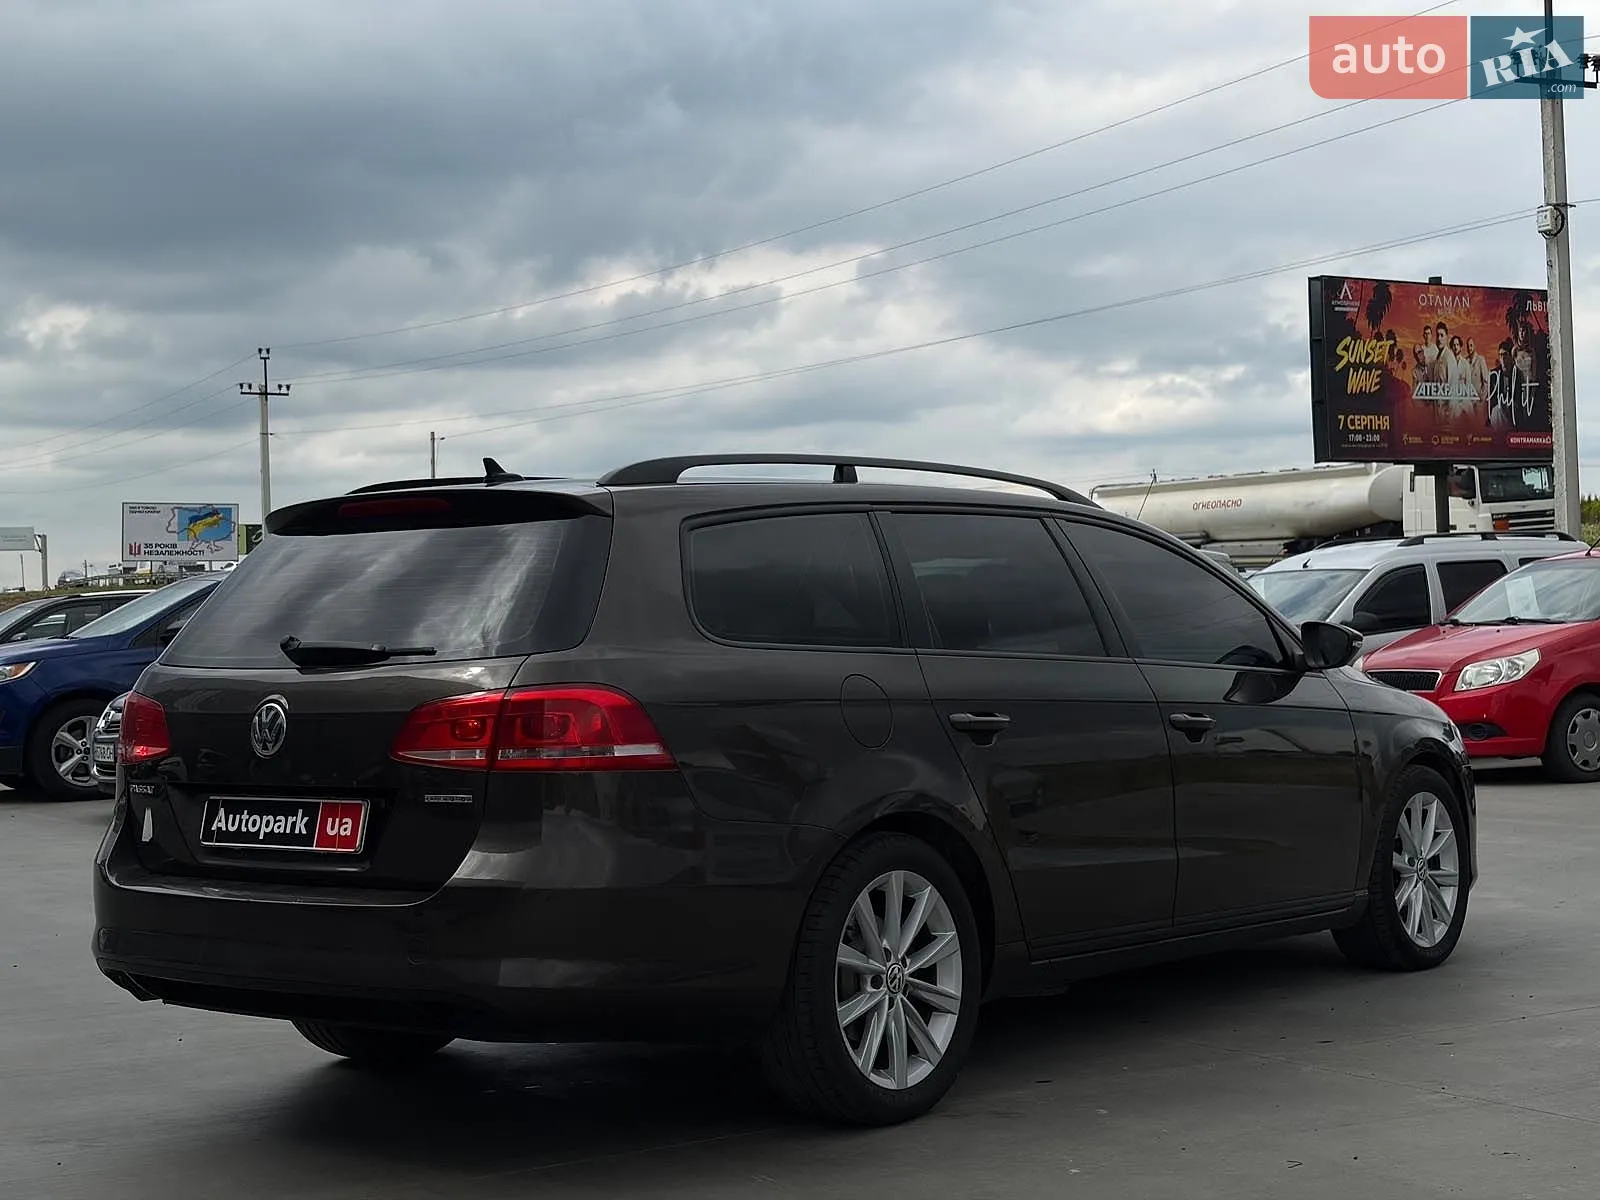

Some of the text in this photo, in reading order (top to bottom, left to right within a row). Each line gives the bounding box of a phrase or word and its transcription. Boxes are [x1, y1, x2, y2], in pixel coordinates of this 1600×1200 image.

[1418, 294, 1470, 308] OTAMAN
[1526, 300, 1548, 312] ЛЬВІ
[1335, 335, 1395, 372] SUNSET
[1347, 367, 1382, 394] WAVE
[1337, 414, 1390, 430] 7 СЕРПНЯ
[1192, 498, 1243, 511] ОГНЕОПАСНО
[211, 807, 353, 840] Autopark ua
